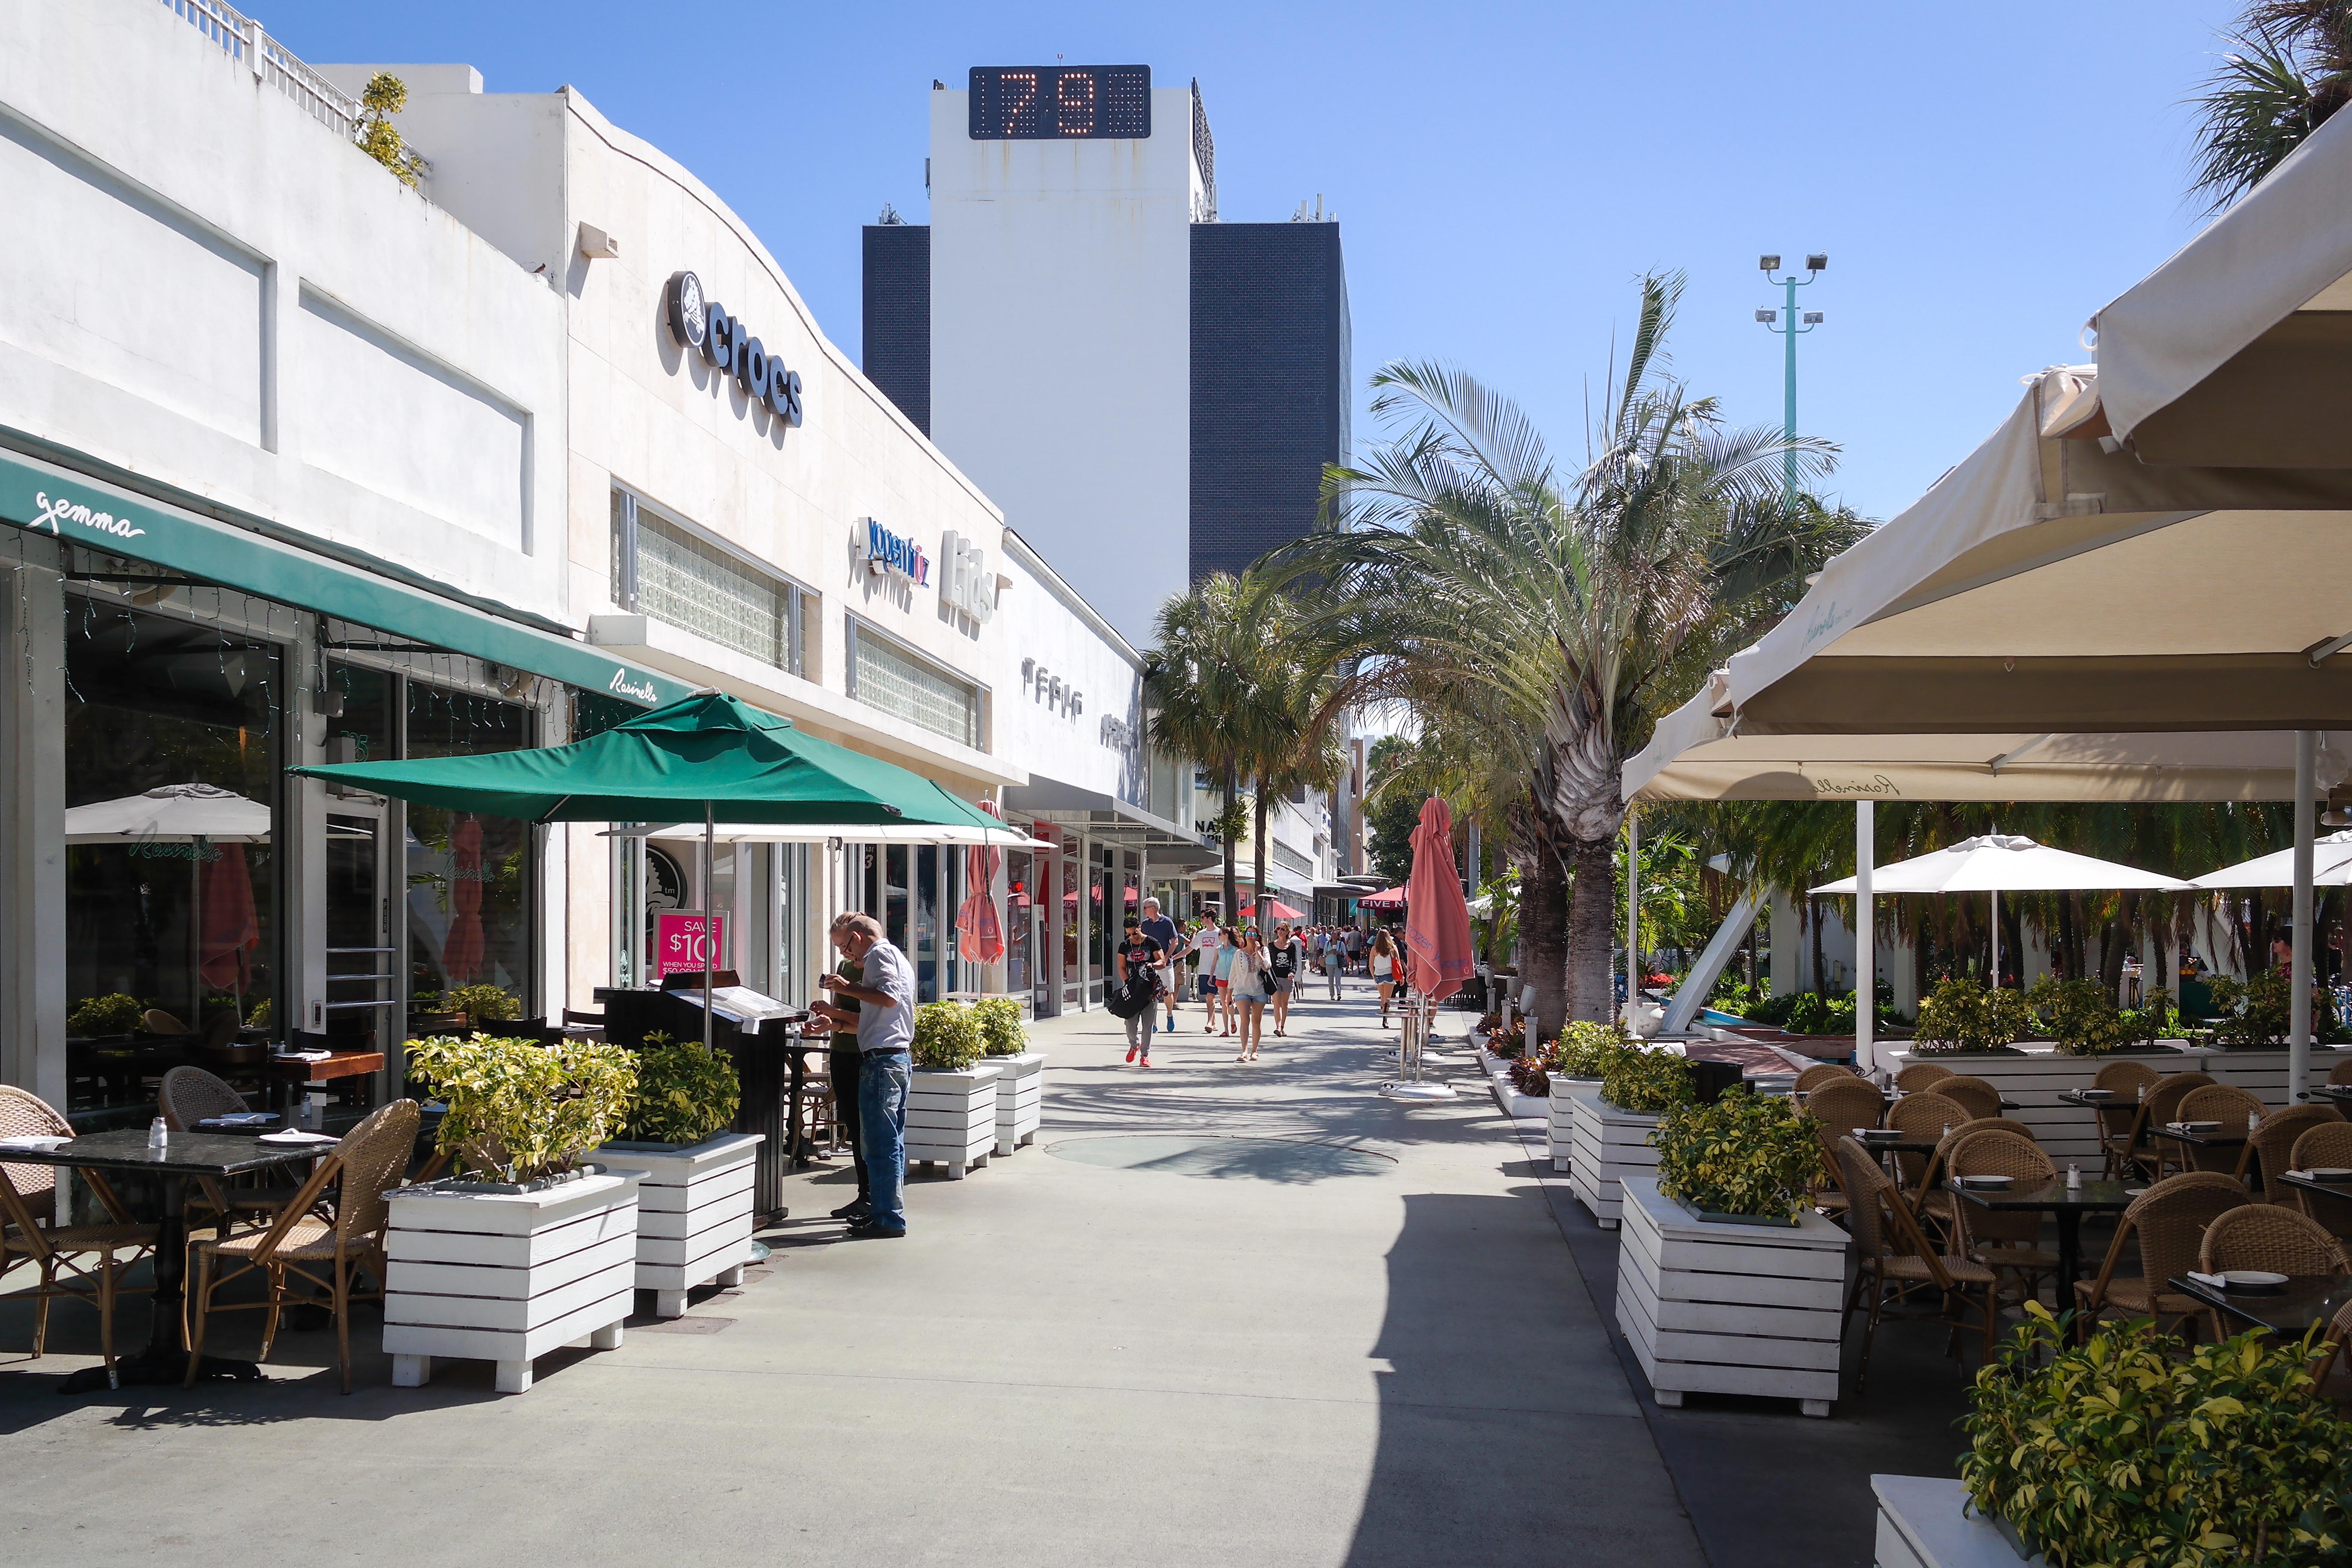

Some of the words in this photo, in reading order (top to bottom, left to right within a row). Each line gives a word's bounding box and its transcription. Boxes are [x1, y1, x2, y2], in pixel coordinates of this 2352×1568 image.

[701, 302, 802, 428] crocs
[26, 491, 146, 536] gemma
[129, 820, 224, 863] Rosinella
[670, 933, 717, 962] $10
